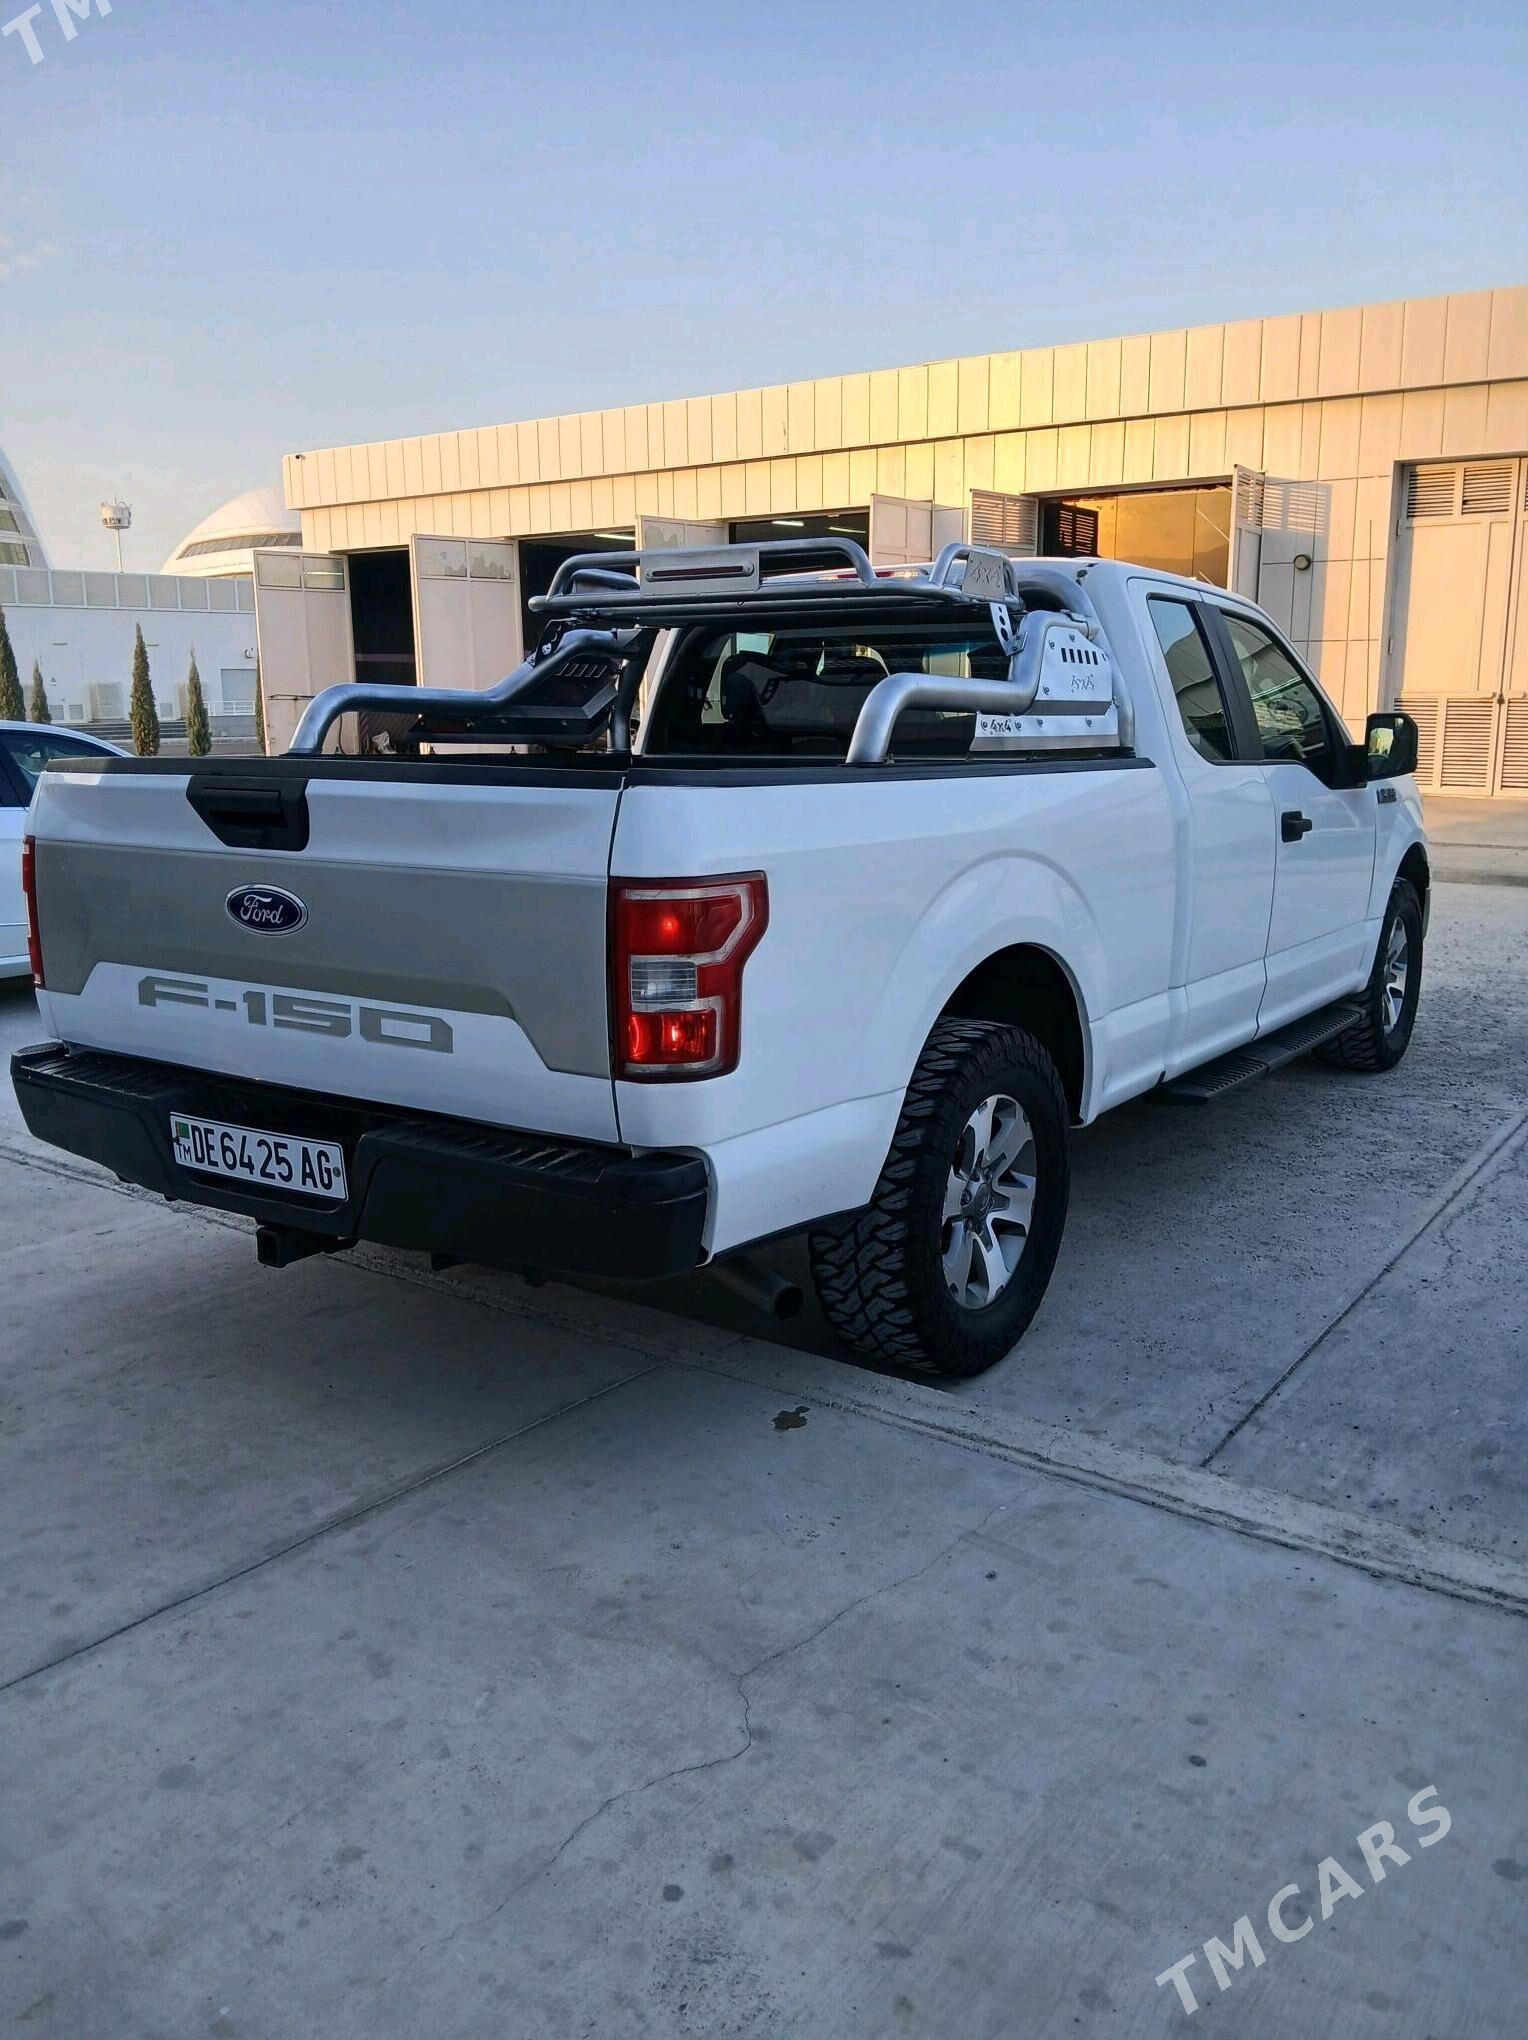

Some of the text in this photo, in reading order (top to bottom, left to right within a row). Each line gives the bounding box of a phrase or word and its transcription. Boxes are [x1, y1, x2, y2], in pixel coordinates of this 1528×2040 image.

[240, 894, 284, 924] Ford
[138, 976, 454, 1054] F-150
[177, 1143, 192, 1162] TM
